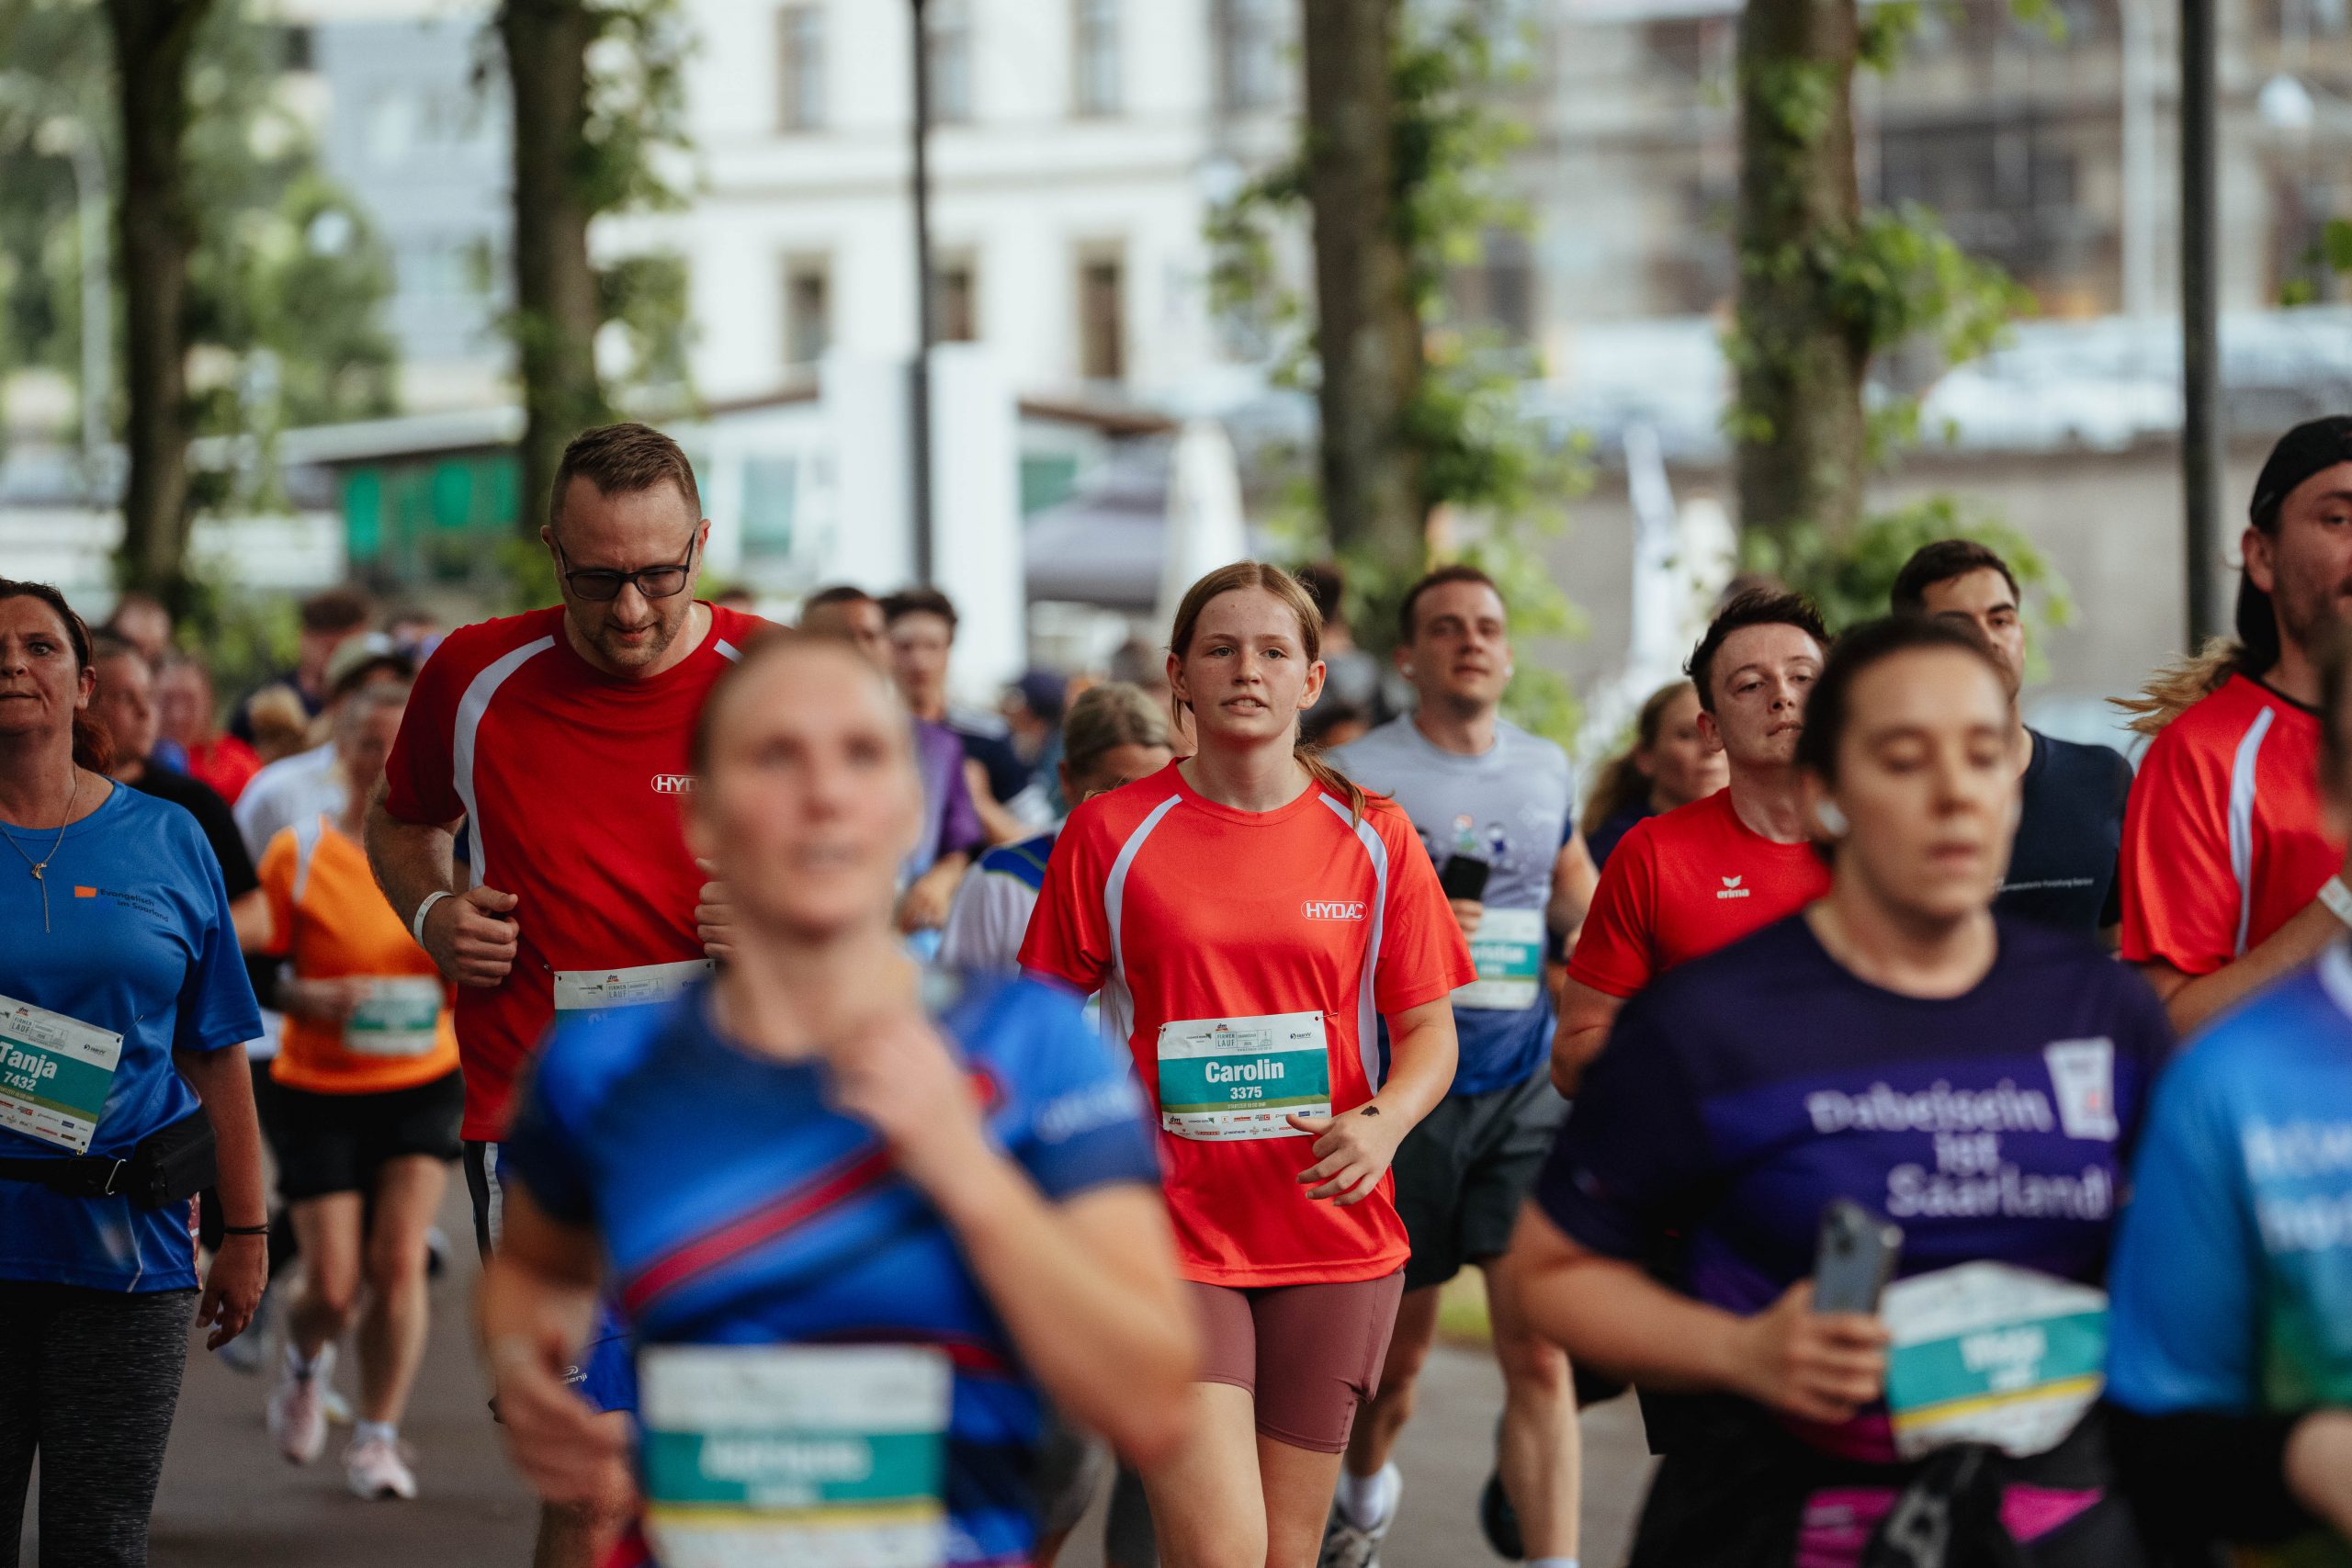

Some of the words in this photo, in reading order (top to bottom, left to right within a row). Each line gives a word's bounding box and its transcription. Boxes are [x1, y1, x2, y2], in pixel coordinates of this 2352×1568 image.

[100, 888, 154, 907] Evangelisch
[1716, 888, 1749, 898] erima
[132, 903, 169, 922] Saarland
[1306, 902, 1364, 919] HYDAC
[1217, 1039, 1235, 1047] LAUF
[0, 1041, 57, 1079] Tanja
[1204, 1058, 1284, 1083] Carolin
[4, 1071, 37, 1092] 7432
[1229, 1086, 1262, 1100] 3375
[1887, 1162, 2111, 1220] Saarland
